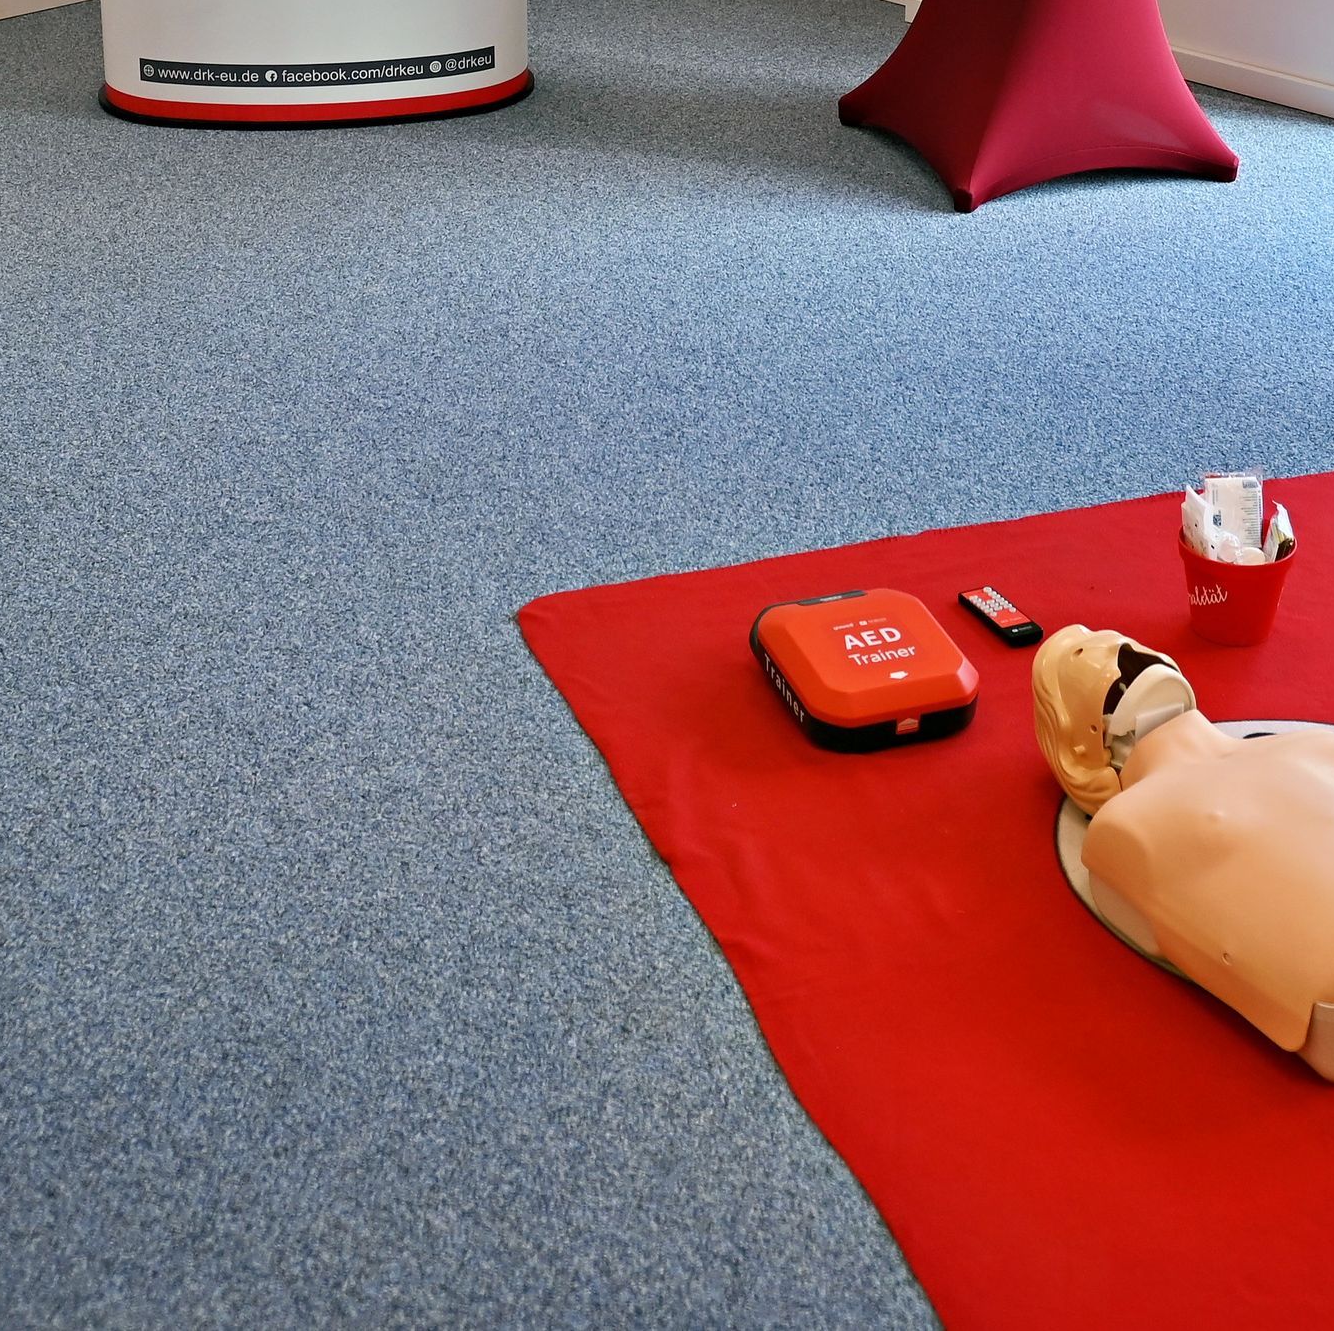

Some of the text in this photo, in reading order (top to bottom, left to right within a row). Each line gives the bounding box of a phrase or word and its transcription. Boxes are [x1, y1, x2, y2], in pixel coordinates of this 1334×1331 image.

[157, 53, 493, 84] www.drk-eu.de facebook.com/drkeu @drkeu
[1187, 583, 1228, 608] alität
[844, 627, 902, 650] AED
[847, 645, 916, 666] Trainer
[763, 652, 807, 723] Trainer
